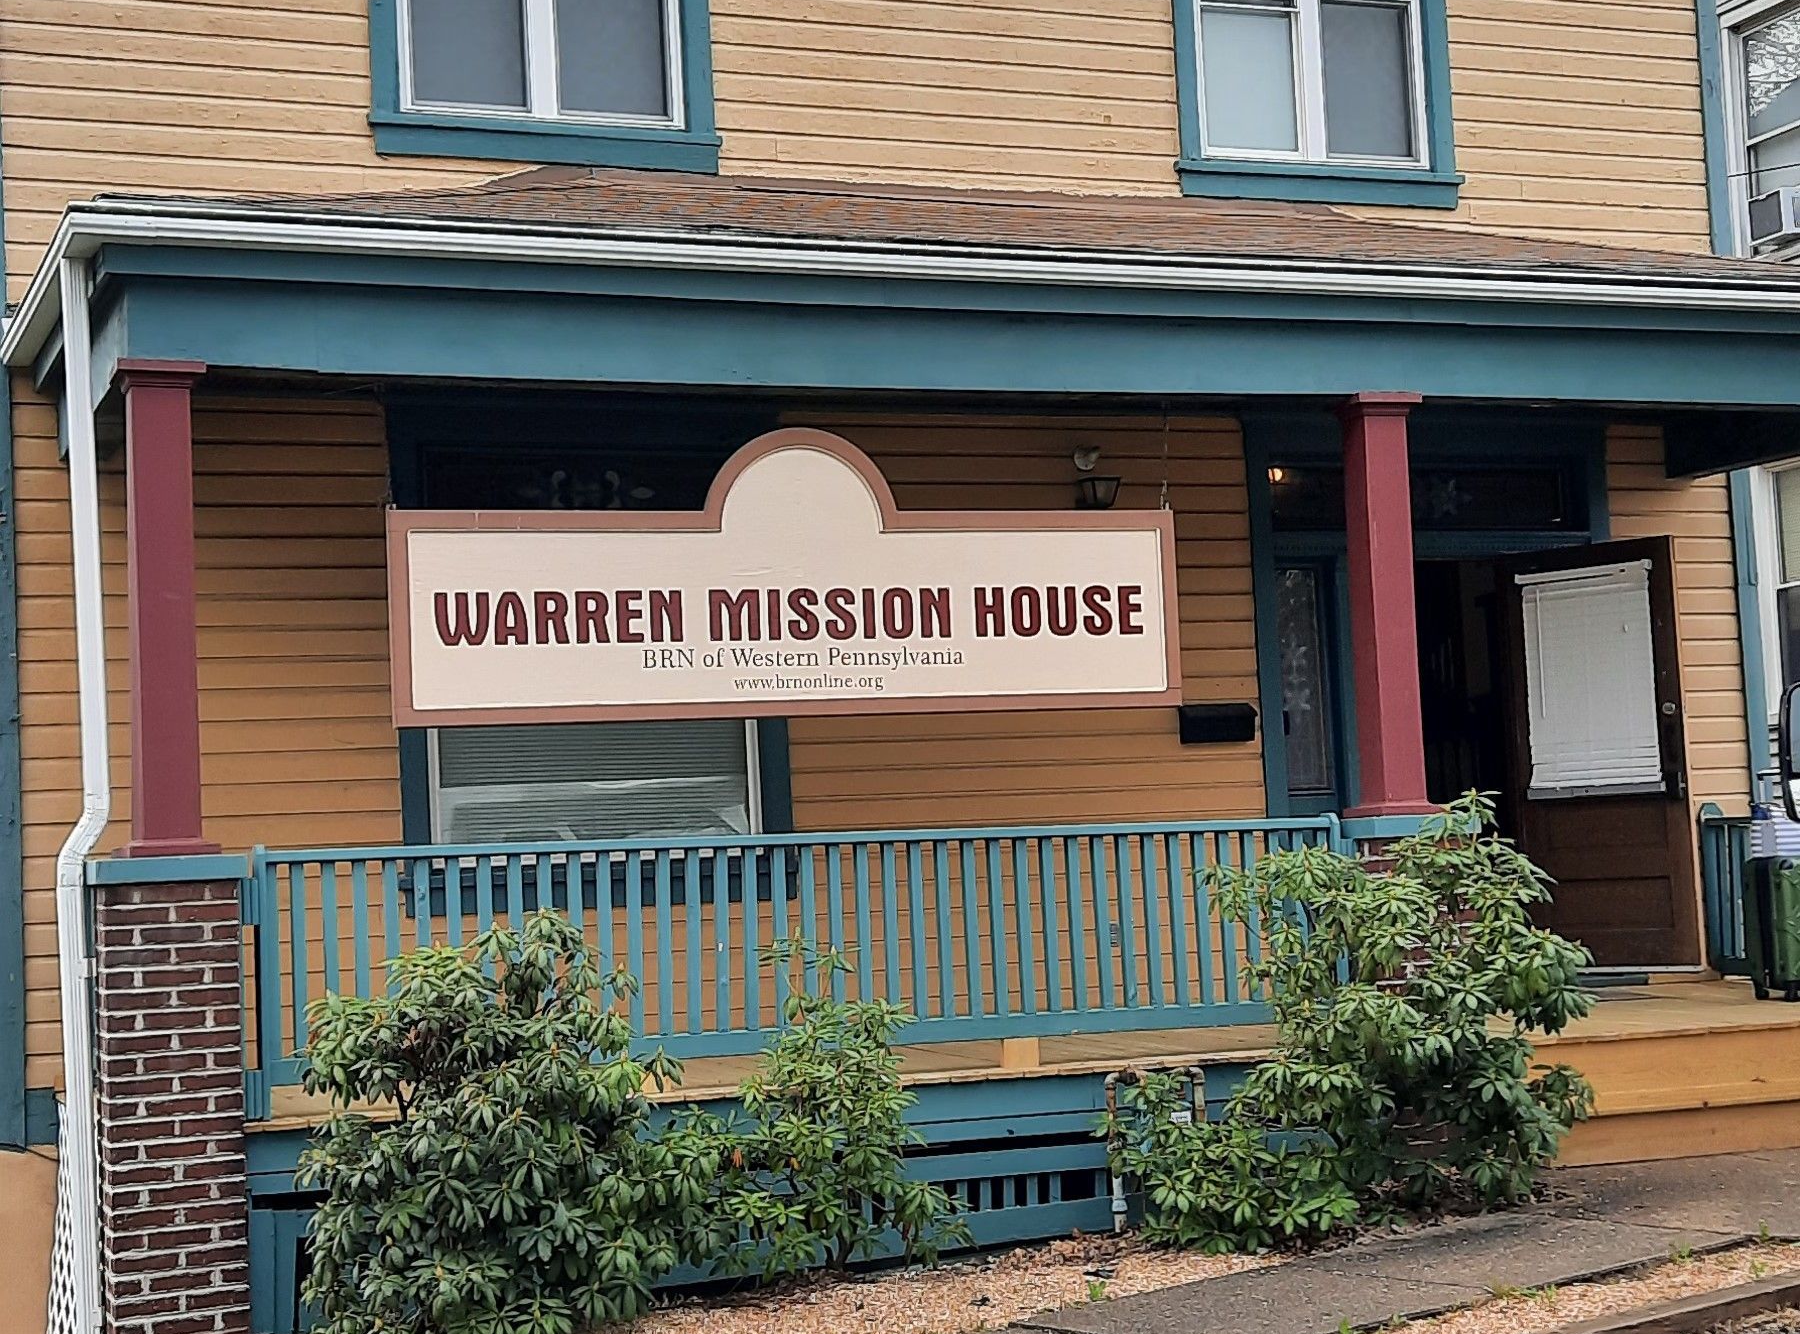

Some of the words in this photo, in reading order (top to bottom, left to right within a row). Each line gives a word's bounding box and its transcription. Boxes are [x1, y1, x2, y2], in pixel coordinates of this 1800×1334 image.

[433, 589, 684, 647] WARREN
[708, 586, 952, 642] MISSION
[973, 584, 1144, 639] HOUSE
[642, 648, 695, 669] BRN
[702, 647, 725, 668] of
[730, 647, 819, 668] Western
[828, 645, 964, 671] Pennsylvania
[734, 673, 884, 691] www.brnonline.org
